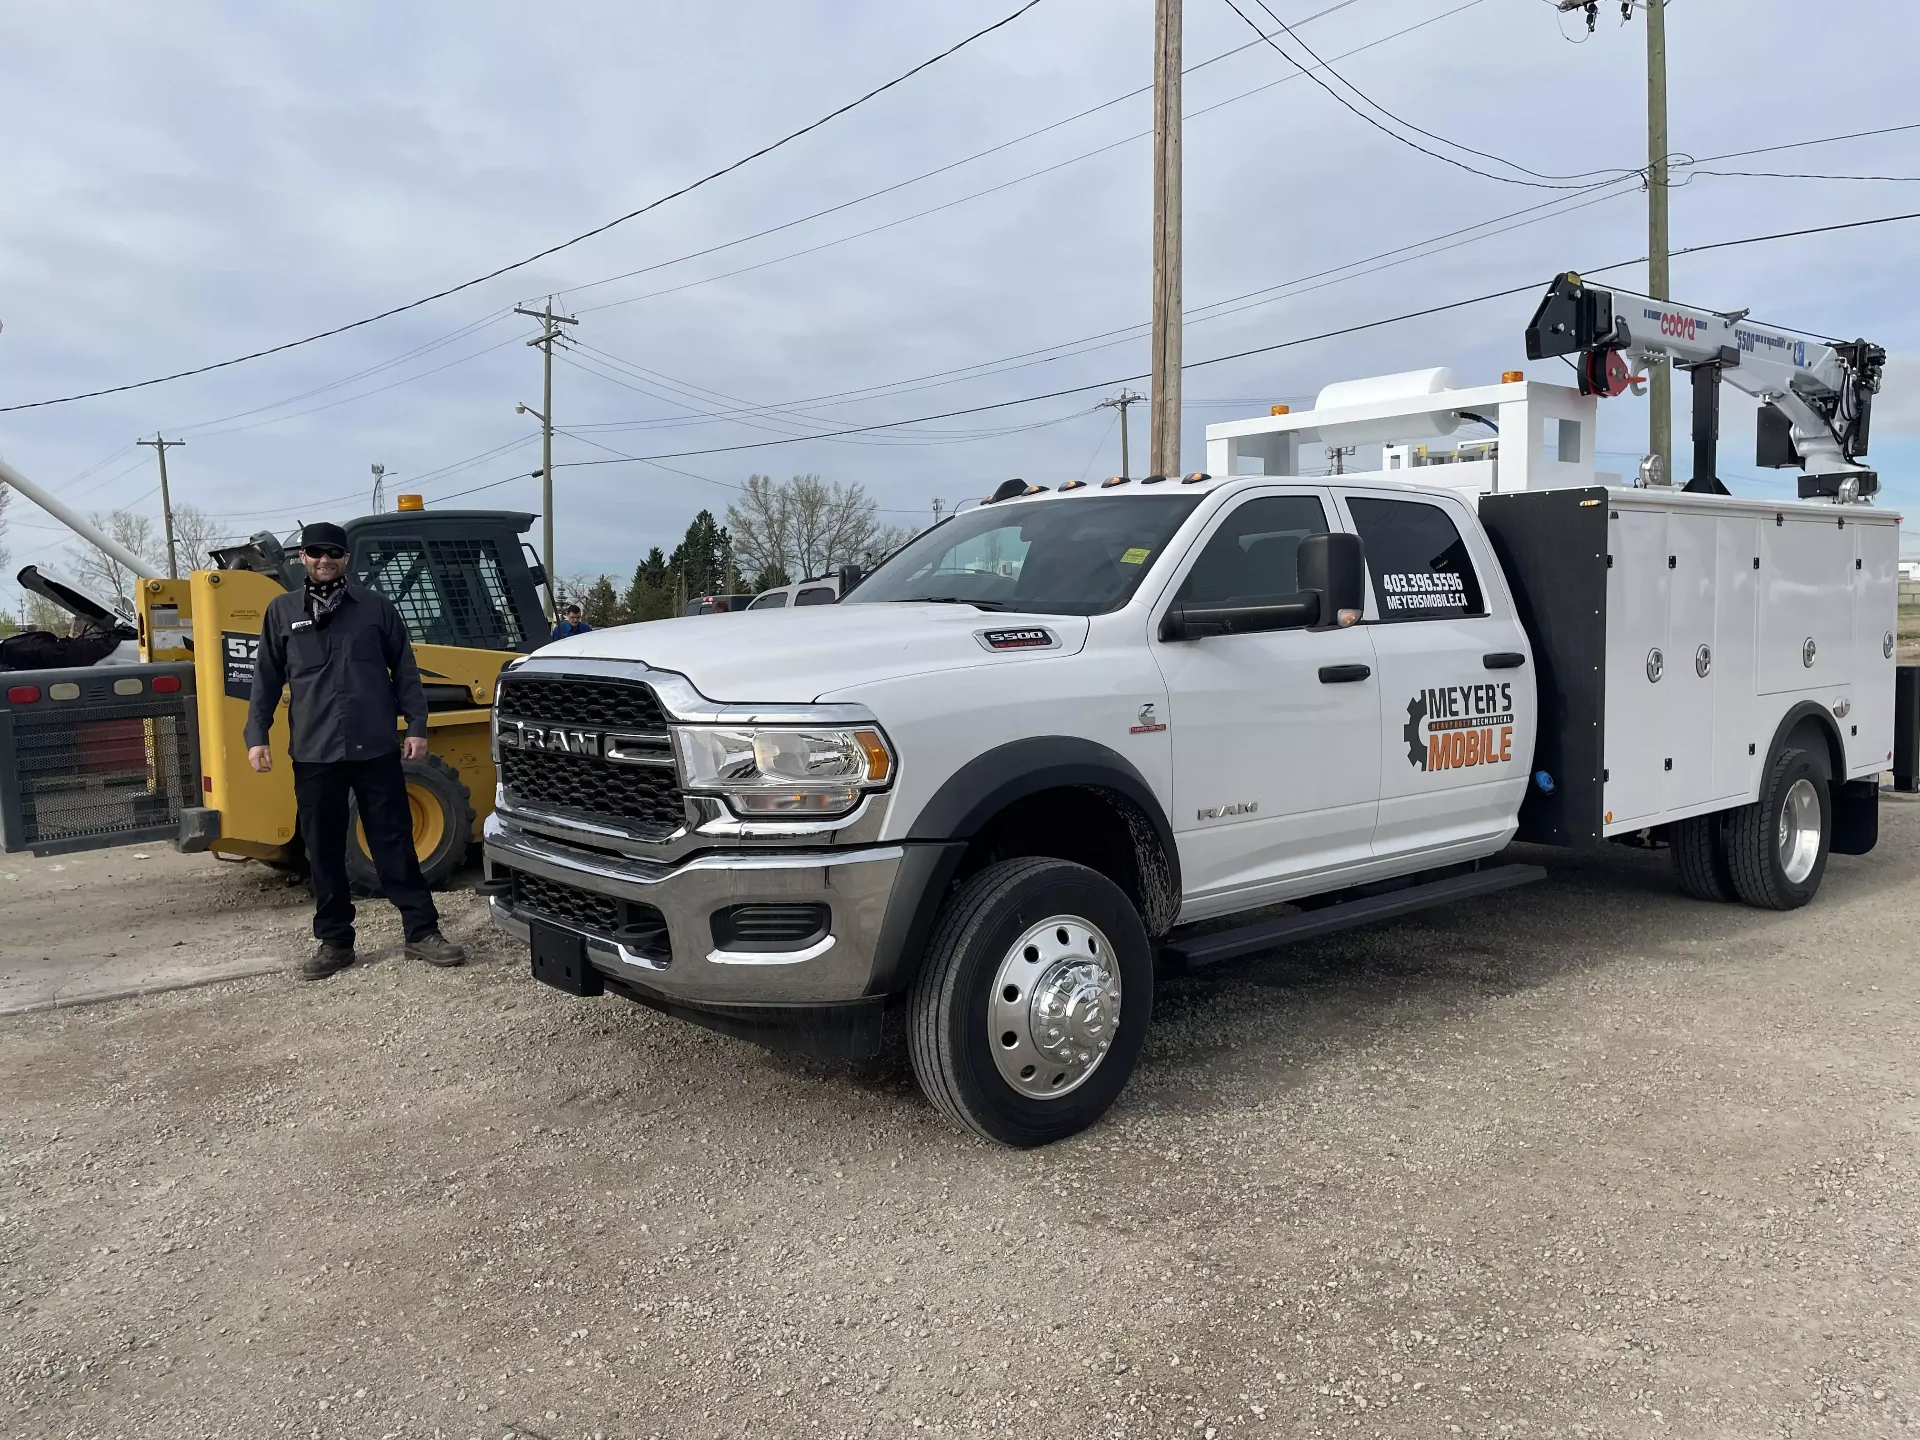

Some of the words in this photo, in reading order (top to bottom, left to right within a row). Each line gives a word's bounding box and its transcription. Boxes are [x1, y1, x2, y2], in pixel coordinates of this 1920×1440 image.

[1661, 312, 1695, 340] cobra
[1738, 330, 1755, 352] 5500
[1383, 572, 1463, 593] 403.396.5596
[1386, 592, 1468, 610] MEYERSMOBILE.CA
[990, 631, 1044, 642] 5500
[1428, 683, 1512, 720] MEYER'S
[1471, 715, 1511, 726] MECHANICAL
[524, 726, 600, 757] RAM
[1428, 726, 1513, 772] MOBILE
[1197, 801, 1259, 820] RAM
